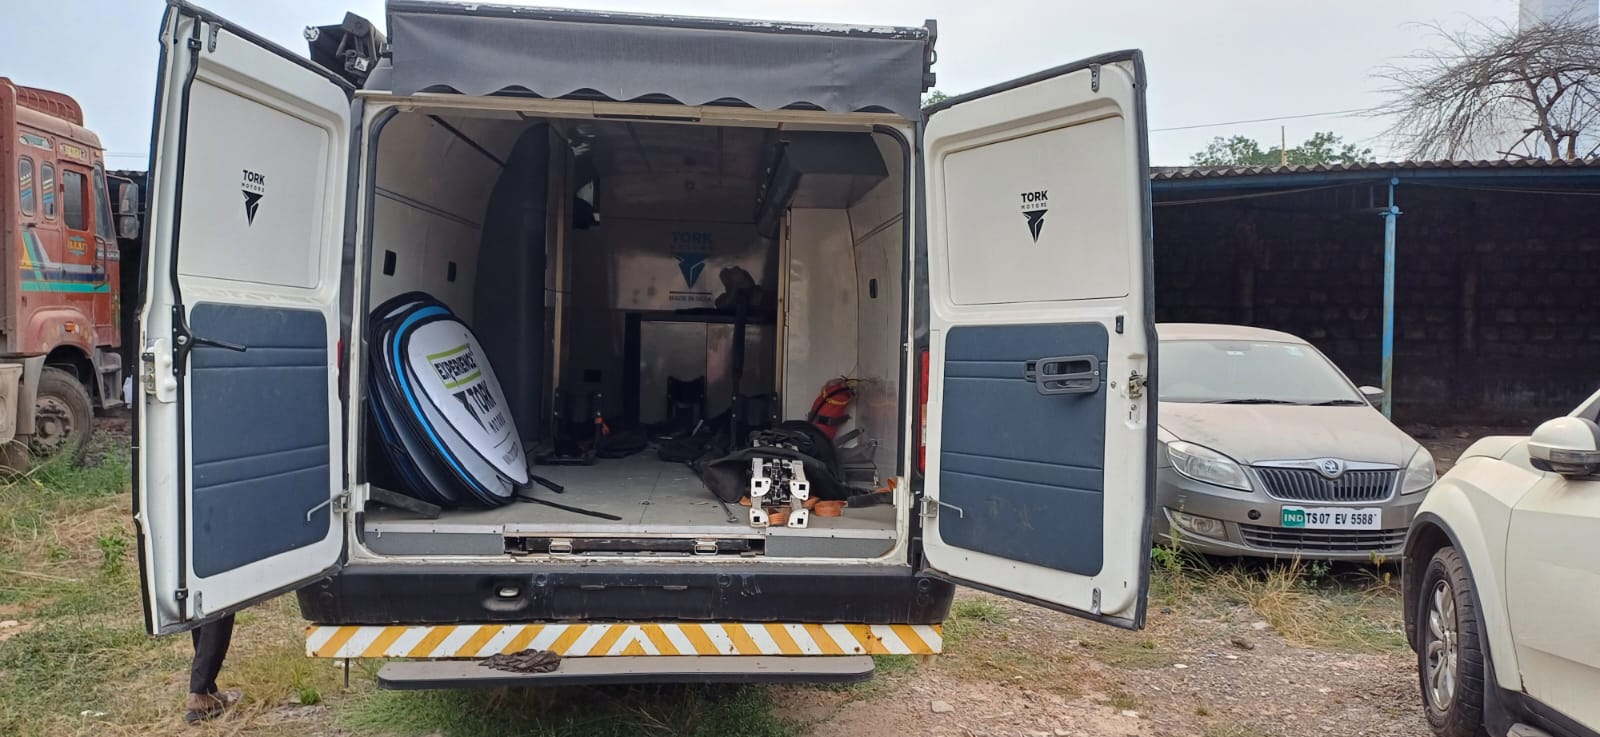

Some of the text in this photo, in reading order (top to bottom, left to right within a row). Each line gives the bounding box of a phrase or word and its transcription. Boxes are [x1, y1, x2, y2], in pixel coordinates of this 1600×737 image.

[242, 169, 265, 186] TORK
[1021, 190, 1048, 203] TORK
[672, 231, 713, 244] TORK
[466, 380, 497, 415] TORK
[1284, 513, 1304, 522] IND
[1306, 513, 1318, 524] TS
[1319, 513, 1330, 524] 07
[1335, 513, 1347, 525] EV
